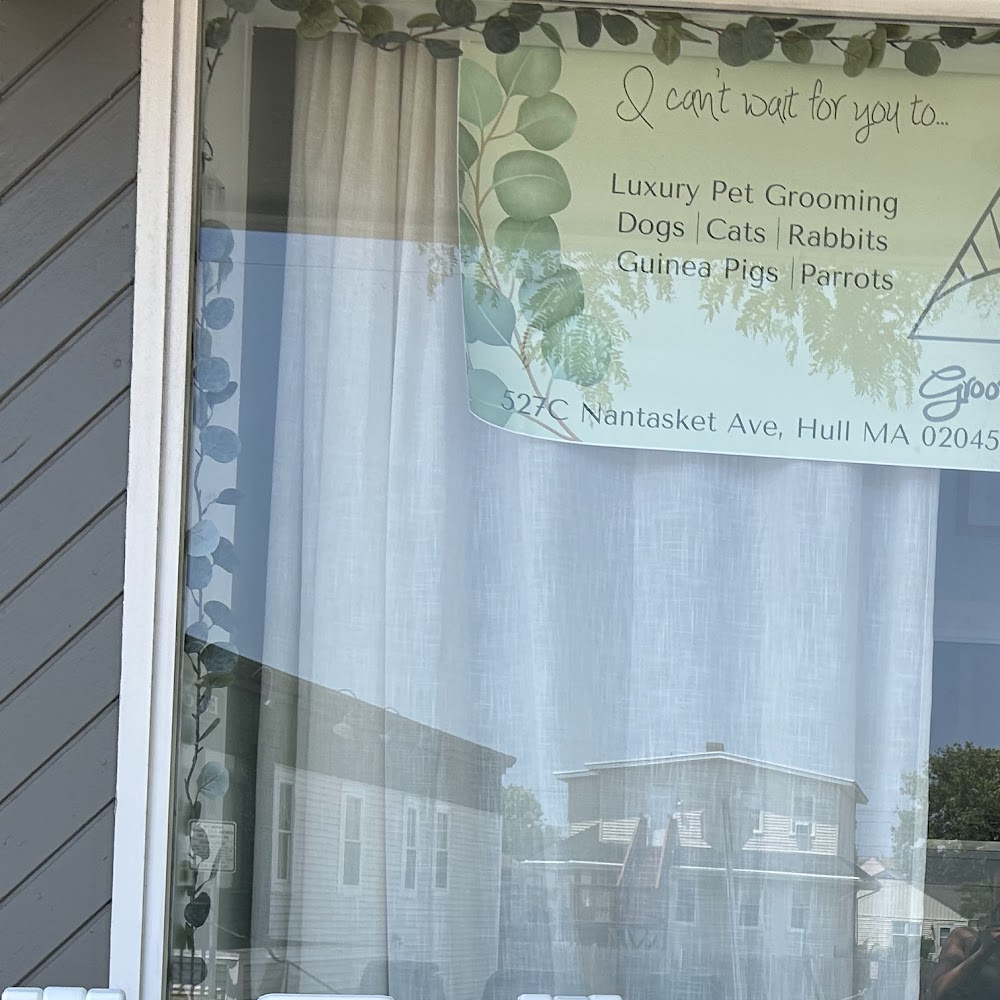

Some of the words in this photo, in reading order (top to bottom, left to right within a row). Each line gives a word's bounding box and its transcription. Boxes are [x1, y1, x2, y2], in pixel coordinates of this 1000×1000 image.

[616, 65, 654, 129] I
[666, 67, 731, 121] can't
[742, 86, 799, 124] wait
[810, 79, 846, 121] for
[850, 99, 900, 144] you
[611, 172, 700, 206] Luxury
[712, 179, 754, 204] Pet
[765, 183, 898, 220] Grooming
[618, 211, 685, 242] Dogs
[706, 217, 766, 243] Cats
[788, 223, 888, 251] Rabbits
[617, 250, 712, 278] Guinea
[725, 257, 778, 284] Pigs
[801, 263, 893, 290] Parrots
[501, 390, 569, 422] 527C
[582, 402, 717, 433] Nantasket
[728, 413, 783, 440] Ave,
[798, 417, 850, 441] Hull
[863, 422, 910, 445] MA
[922, 426, 1000, 451] 02045
